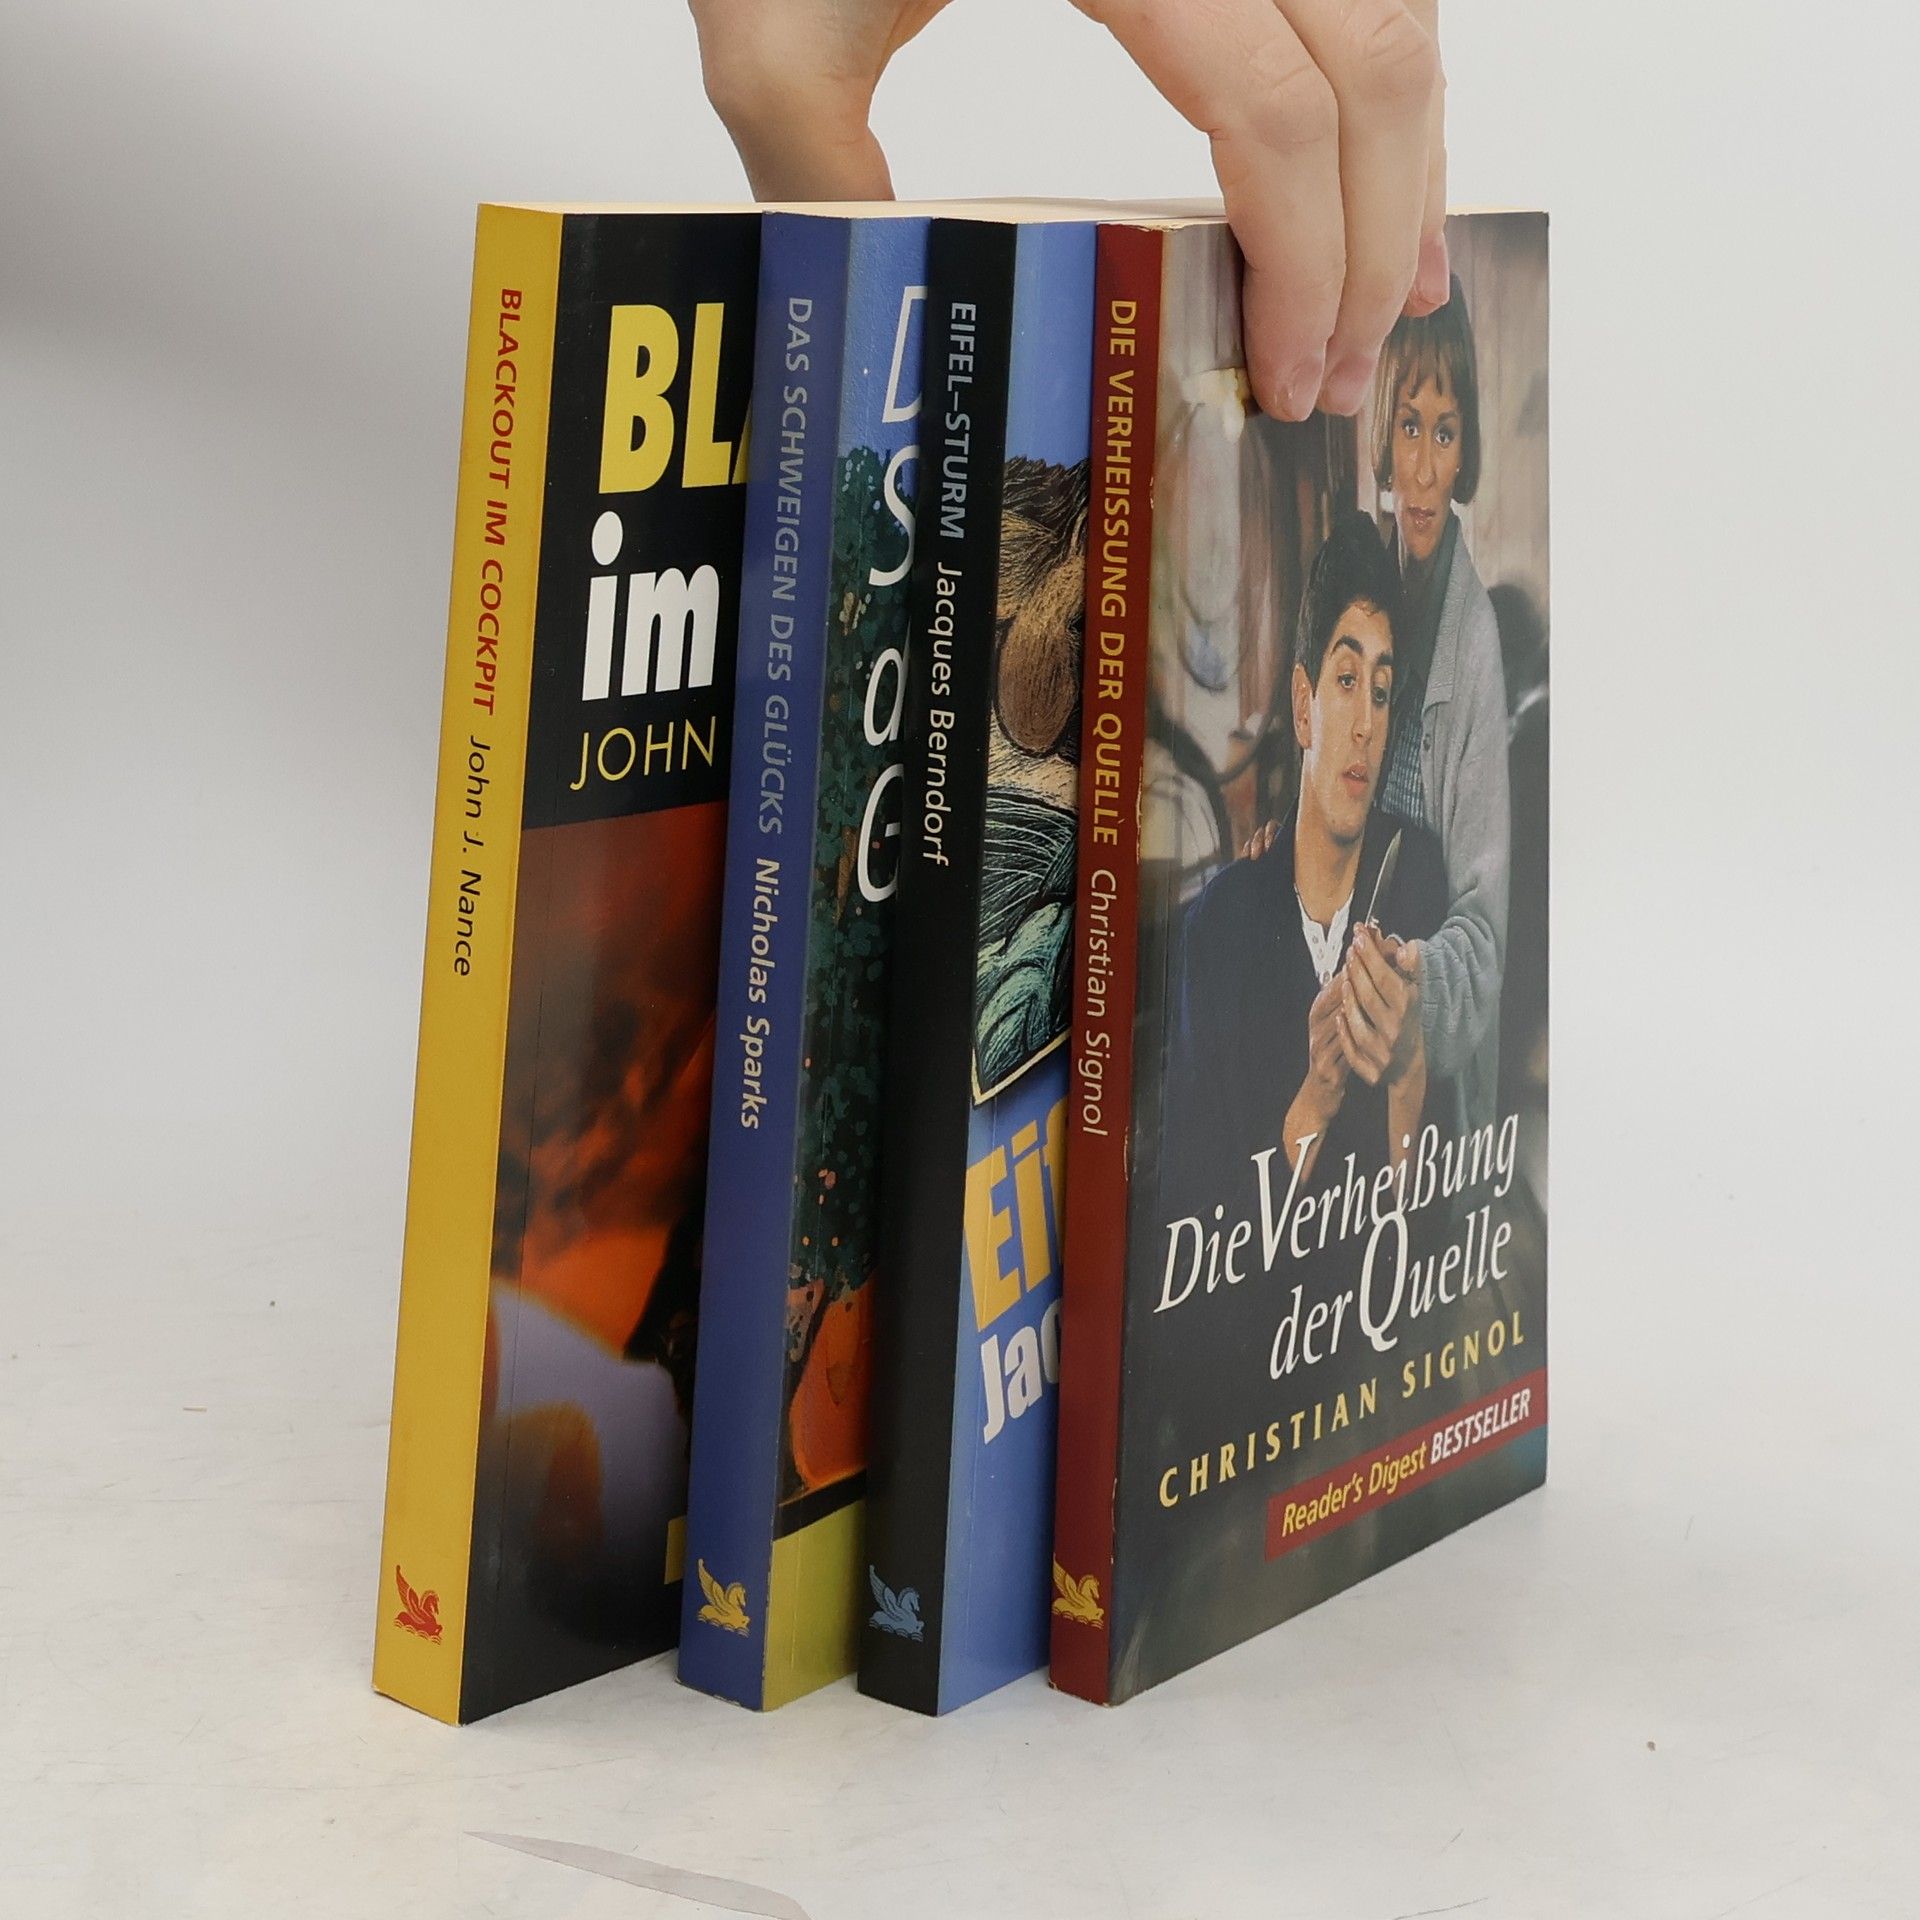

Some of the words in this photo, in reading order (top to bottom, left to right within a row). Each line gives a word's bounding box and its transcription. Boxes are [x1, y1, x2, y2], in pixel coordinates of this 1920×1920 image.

[488, 288, 523, 490] BLACKOUT
[598, 302, 749, 494] BL
[785, 296, 813, 373] DAS
[1110, 299, 1137, 357] DIE
[484, 499, 508, 546] IM
[771, 385, 808, 602] SCHWEIGEN
[1099, 369, 1135, 619] VERHEISSUNG
[473, 558, 503, 716] COCKPIT
[582, 510, 720, 701] im
[767, 613, 795, 682] DES
[925, 561, 962, 698] Jacques
[1096, 630, 1125, 700] DER
[464, 734, 491, 819] John
[570, 715, 716, 791] JOHN
[758, 694, 792, 835] GLÜCKS
[922, 708, 956, 867] Berndorf
[1092, 712, 1123, 846] QUELLE
[462, 829, 485, 854] J.
[453, 869, 482, 977] Nance
[748, 857, 780, 1004] Nicholas
[1087, 868, 1118, 1018] Christian
[741, 1015, 770, 1130] Sparks
[1078, 1031, 1111, 1137] Signol
[1152, 1204, 1252, 1313] Die
[1251, 1112, 1520, 1272] Verheißung
[1269, 1284, 1354, 1381] der
[1359, 1205, 1512, 1353] Quelle
[1158, 1377, 1377, 1508] CHRISTIAN
[1402, 1311, 1525, 1398] SIGNOL
[1281, 1475, 1364, 1538] Reader's
[1368, 1443, 1428, 1495] Digest
[1430, 1387, 1532, 1465] BESTSELLER
